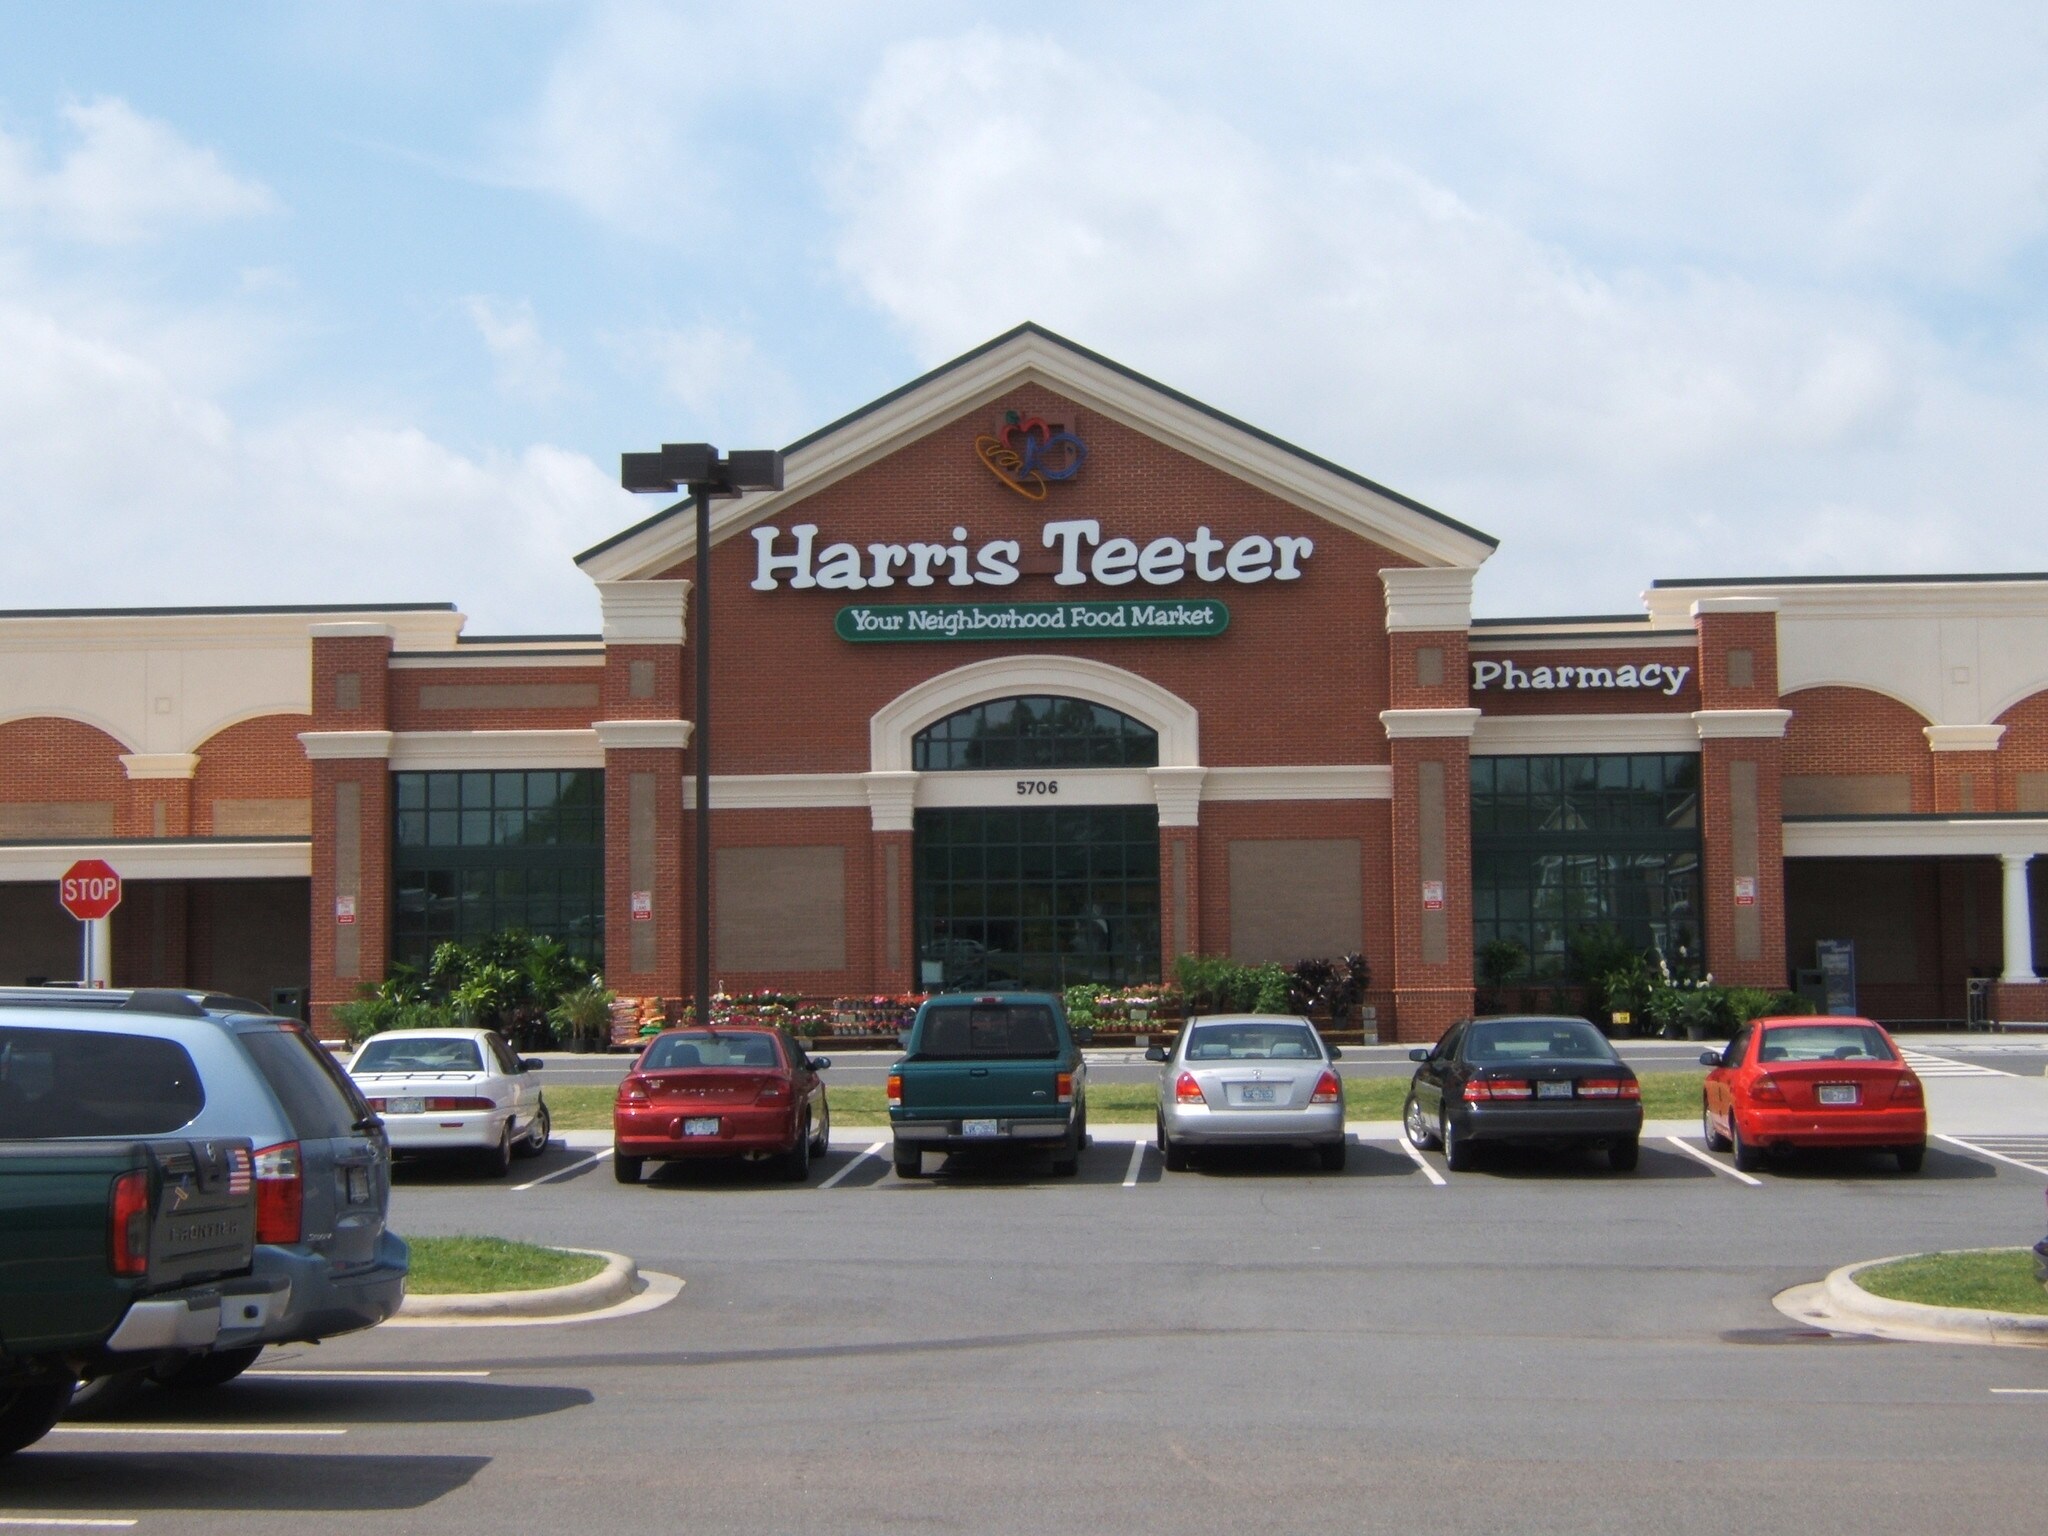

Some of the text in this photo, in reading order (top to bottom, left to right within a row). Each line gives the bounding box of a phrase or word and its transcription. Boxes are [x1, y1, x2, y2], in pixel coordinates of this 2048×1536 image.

[750, 519, 1314, 591] Harris Teeter
[851, 605, 1214, 636] Your Neighborhood Food Market
[1472, 659, 1690, 696] Pharmacy
[1016, 780, 1058, 795] 5706
[65, 877, 117, 901] STOP
